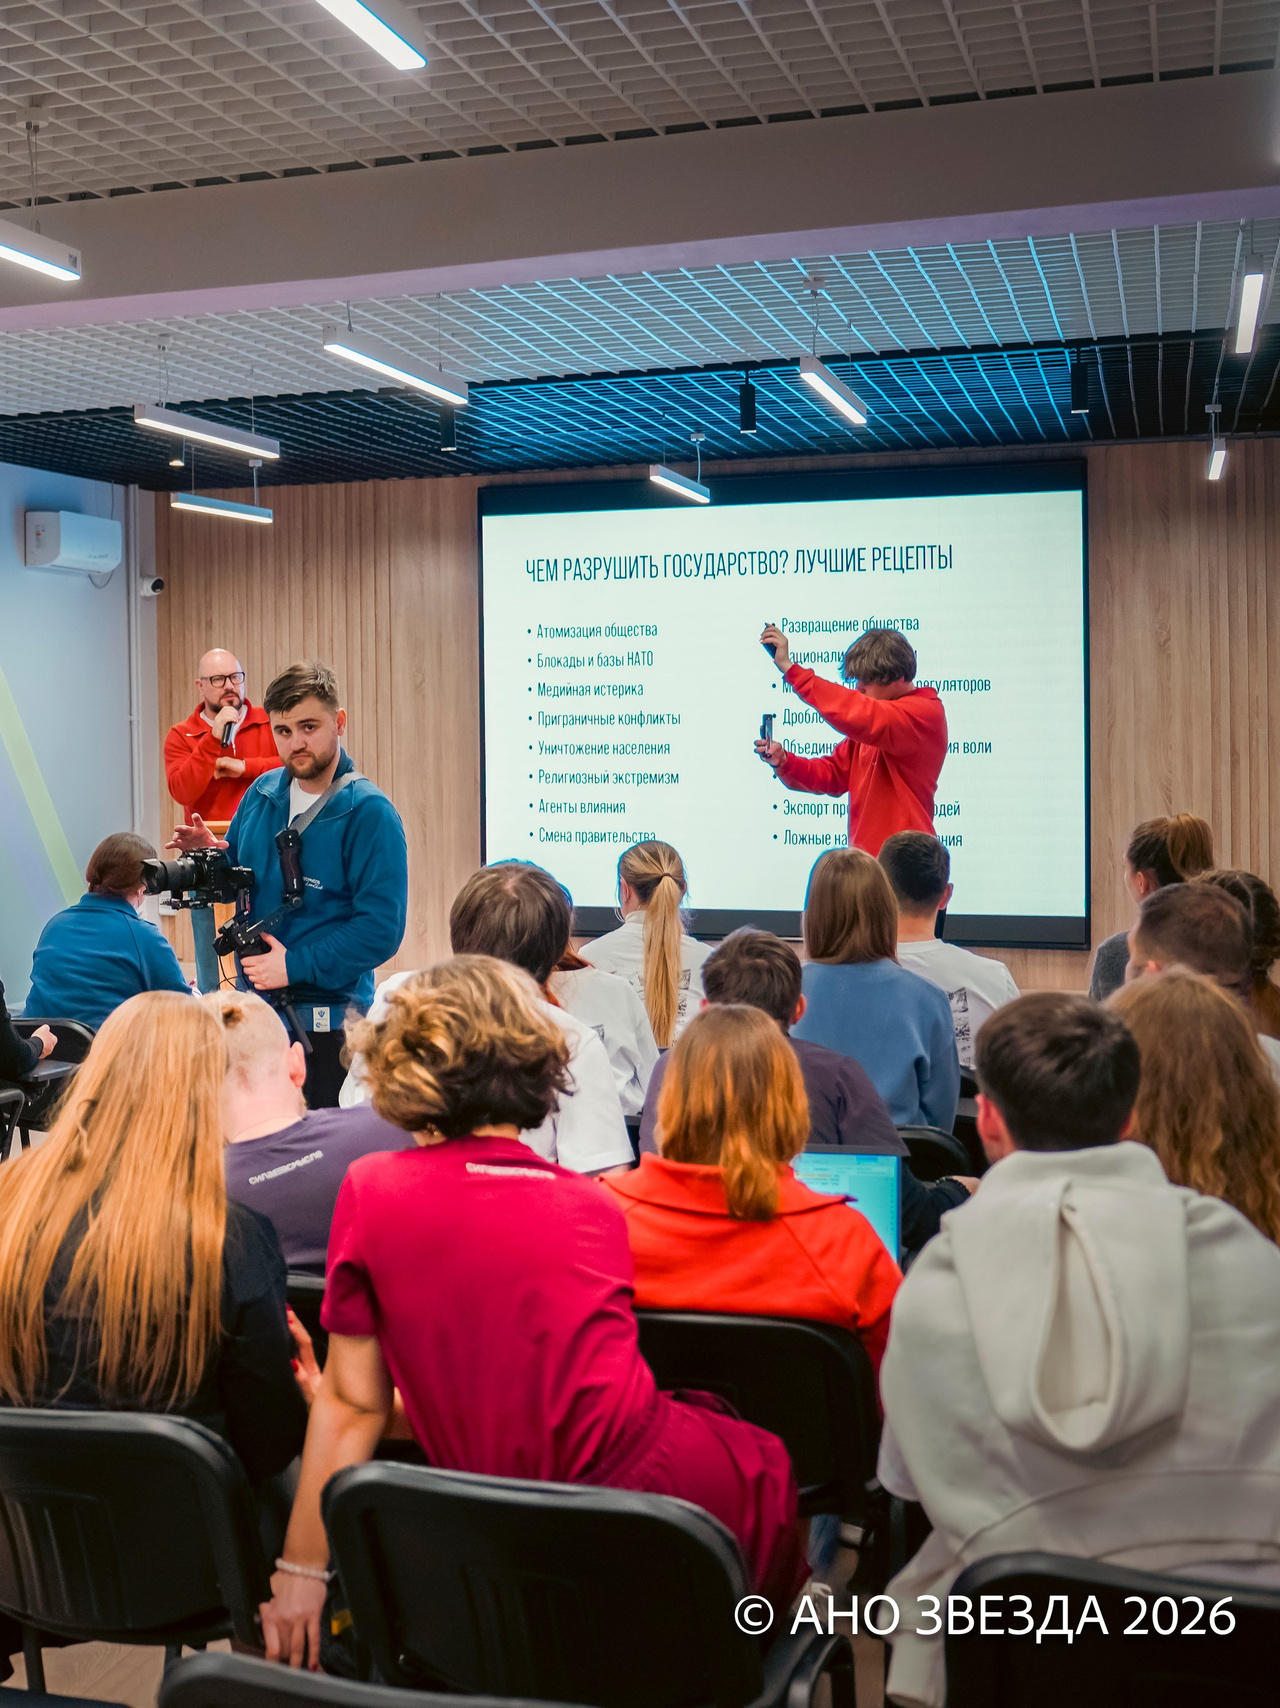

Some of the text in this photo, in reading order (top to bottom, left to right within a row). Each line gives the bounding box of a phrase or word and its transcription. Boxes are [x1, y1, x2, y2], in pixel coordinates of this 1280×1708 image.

[526, 544, 953, 583] ЧЕМ РАЗРУШИТЬ ГОСУДАРСТВО? ЛУЧШИЕ РЕЦЕПТЫ
[537, 622, 658, 639] Атомизация общества
[782, 616, 919, 635] Развращение общества
[537, 650, 654, 669] Блокады и базы НАТО
[537, 682, 644, 699] Медийная истерика
[537, 710, 681, 728] Приграничные конфликты
[538, 740, 671, 755] Уничтожение населения
[963, 741, 992, 754] воли
[538, 769, 680, 787] Религиозный экстремизм
[538, 798, 626, 814] Агенты влияния
[783, 799, 830, 818] Экспорт
[539, 826, 656, 846] Смена правительства
[783, 829, 831, 846] Ложные
